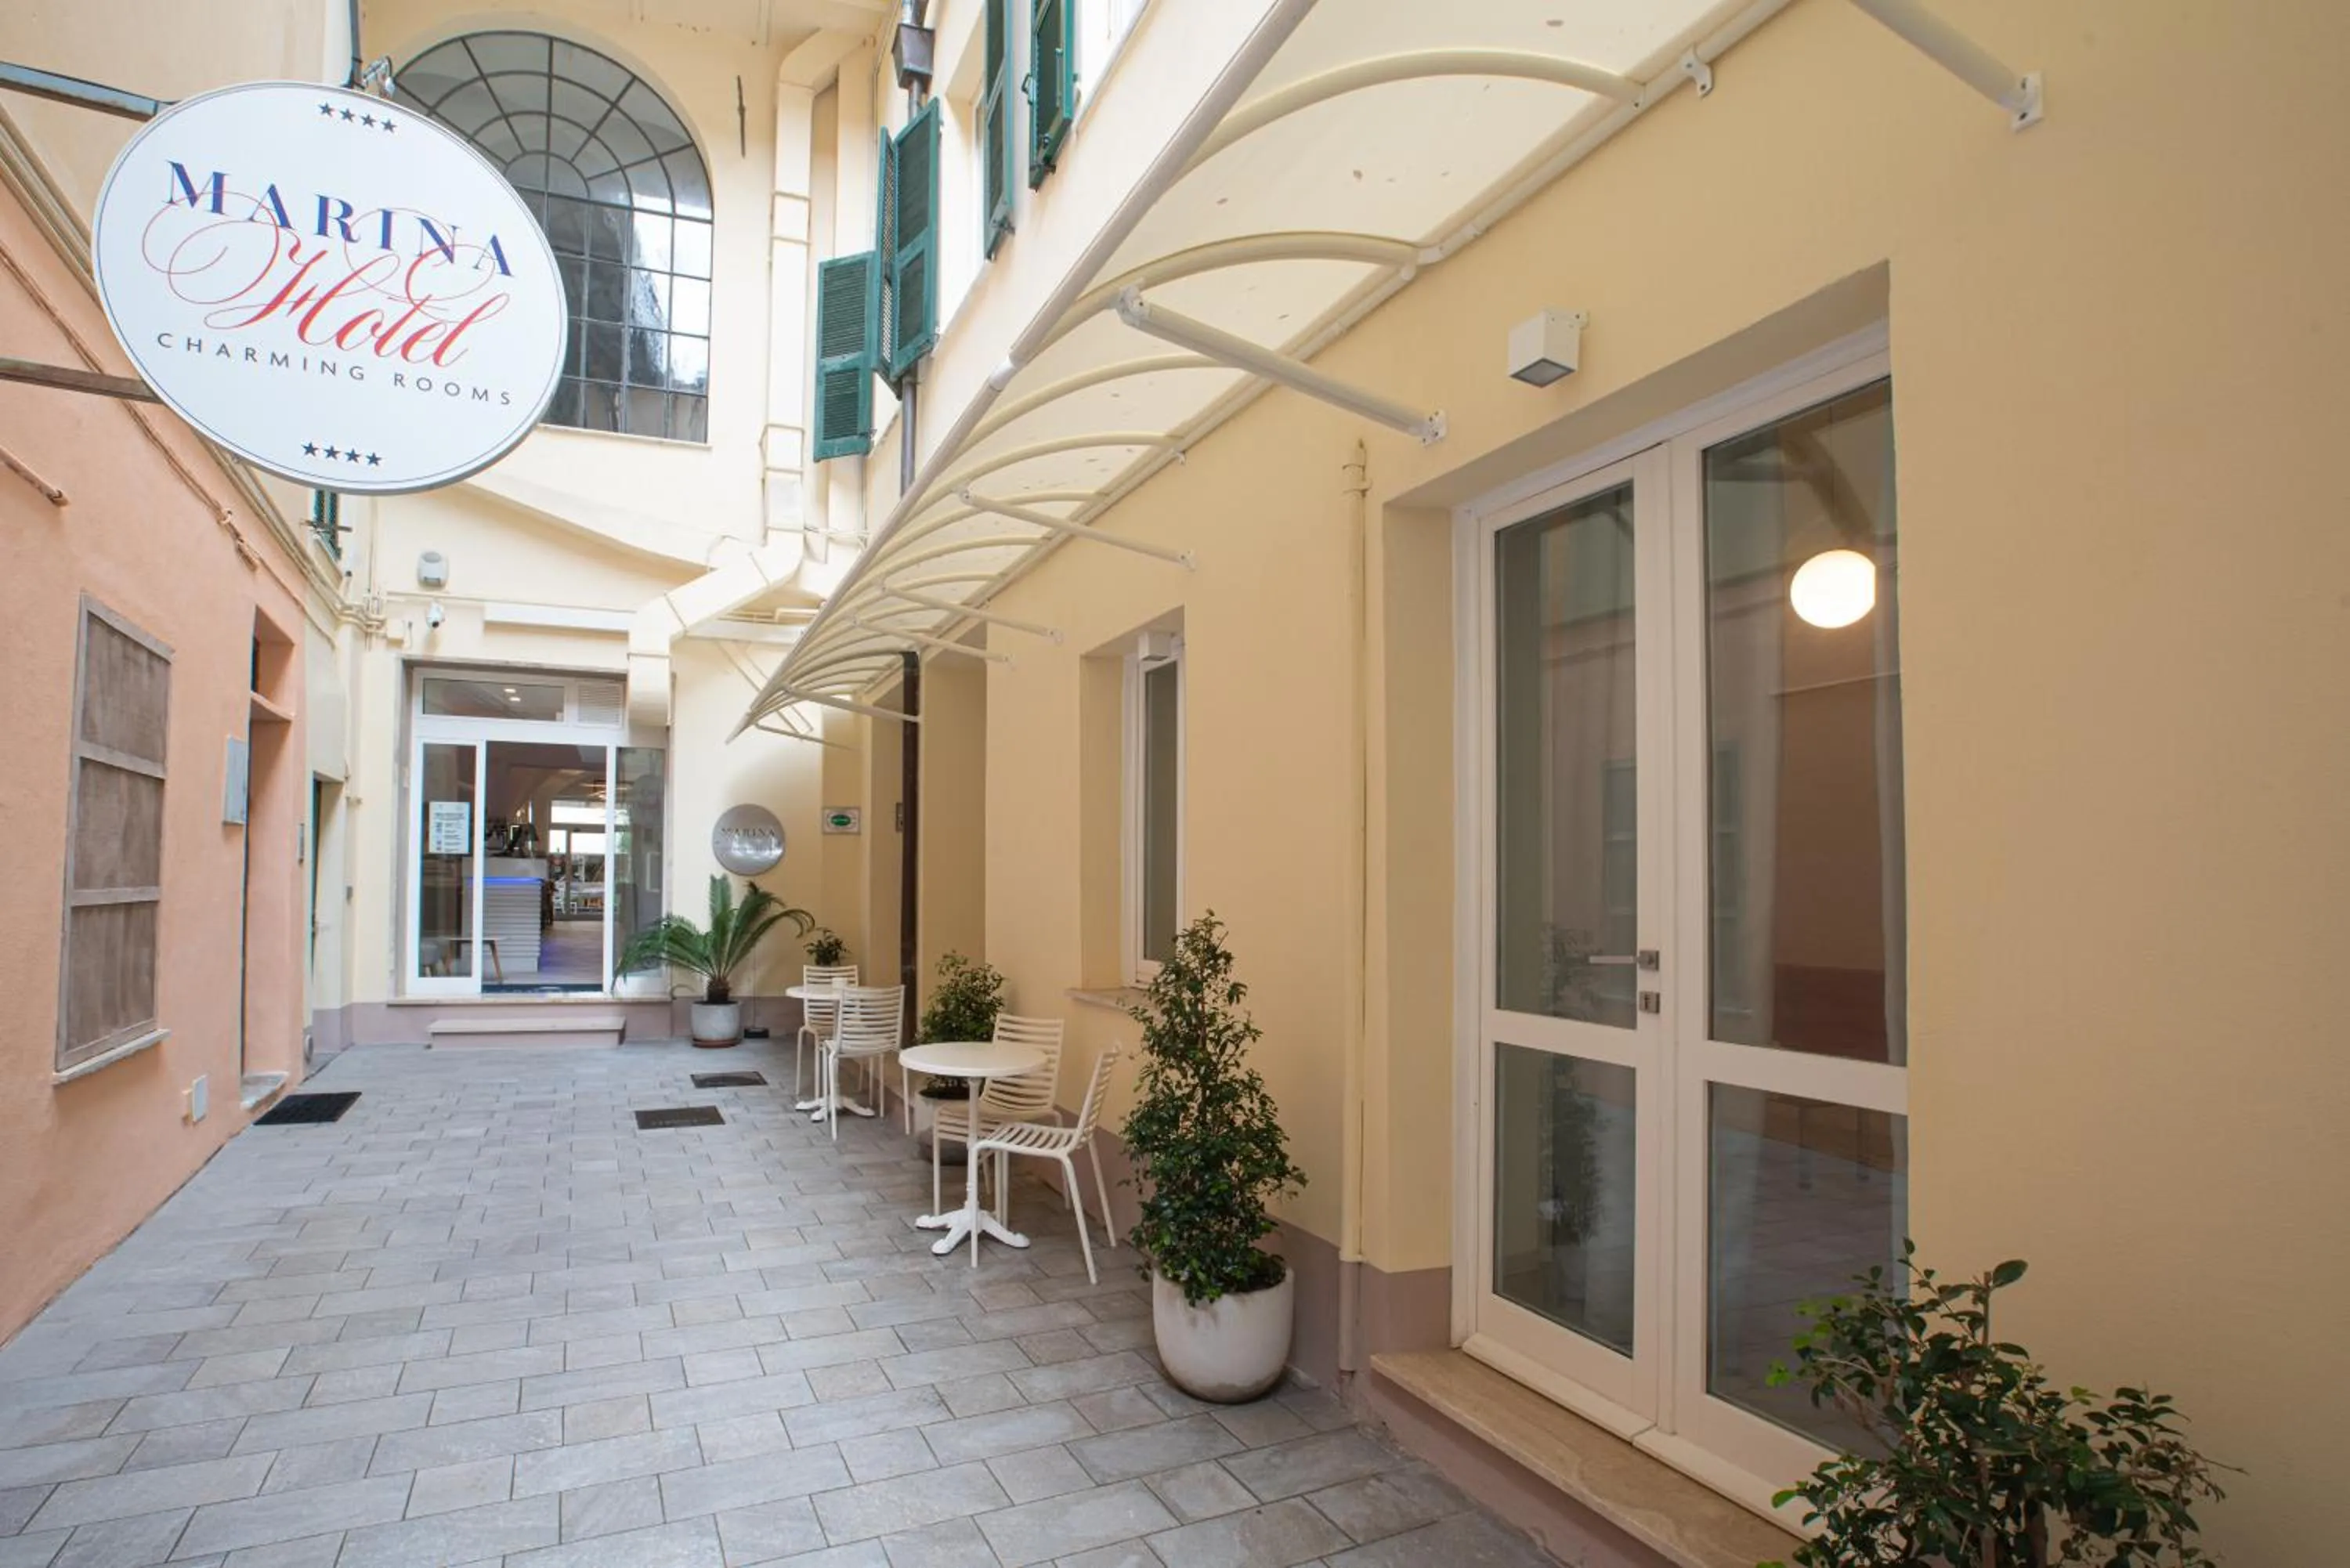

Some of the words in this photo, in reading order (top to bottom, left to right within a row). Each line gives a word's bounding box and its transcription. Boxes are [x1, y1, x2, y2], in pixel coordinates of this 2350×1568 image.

[163, 160, 514, 277] MARINA
[143, 192, 509, 367] Hotel
[157, 332, 365, 381] CHARMING
[394, 372, 512, 406] ROOMS
